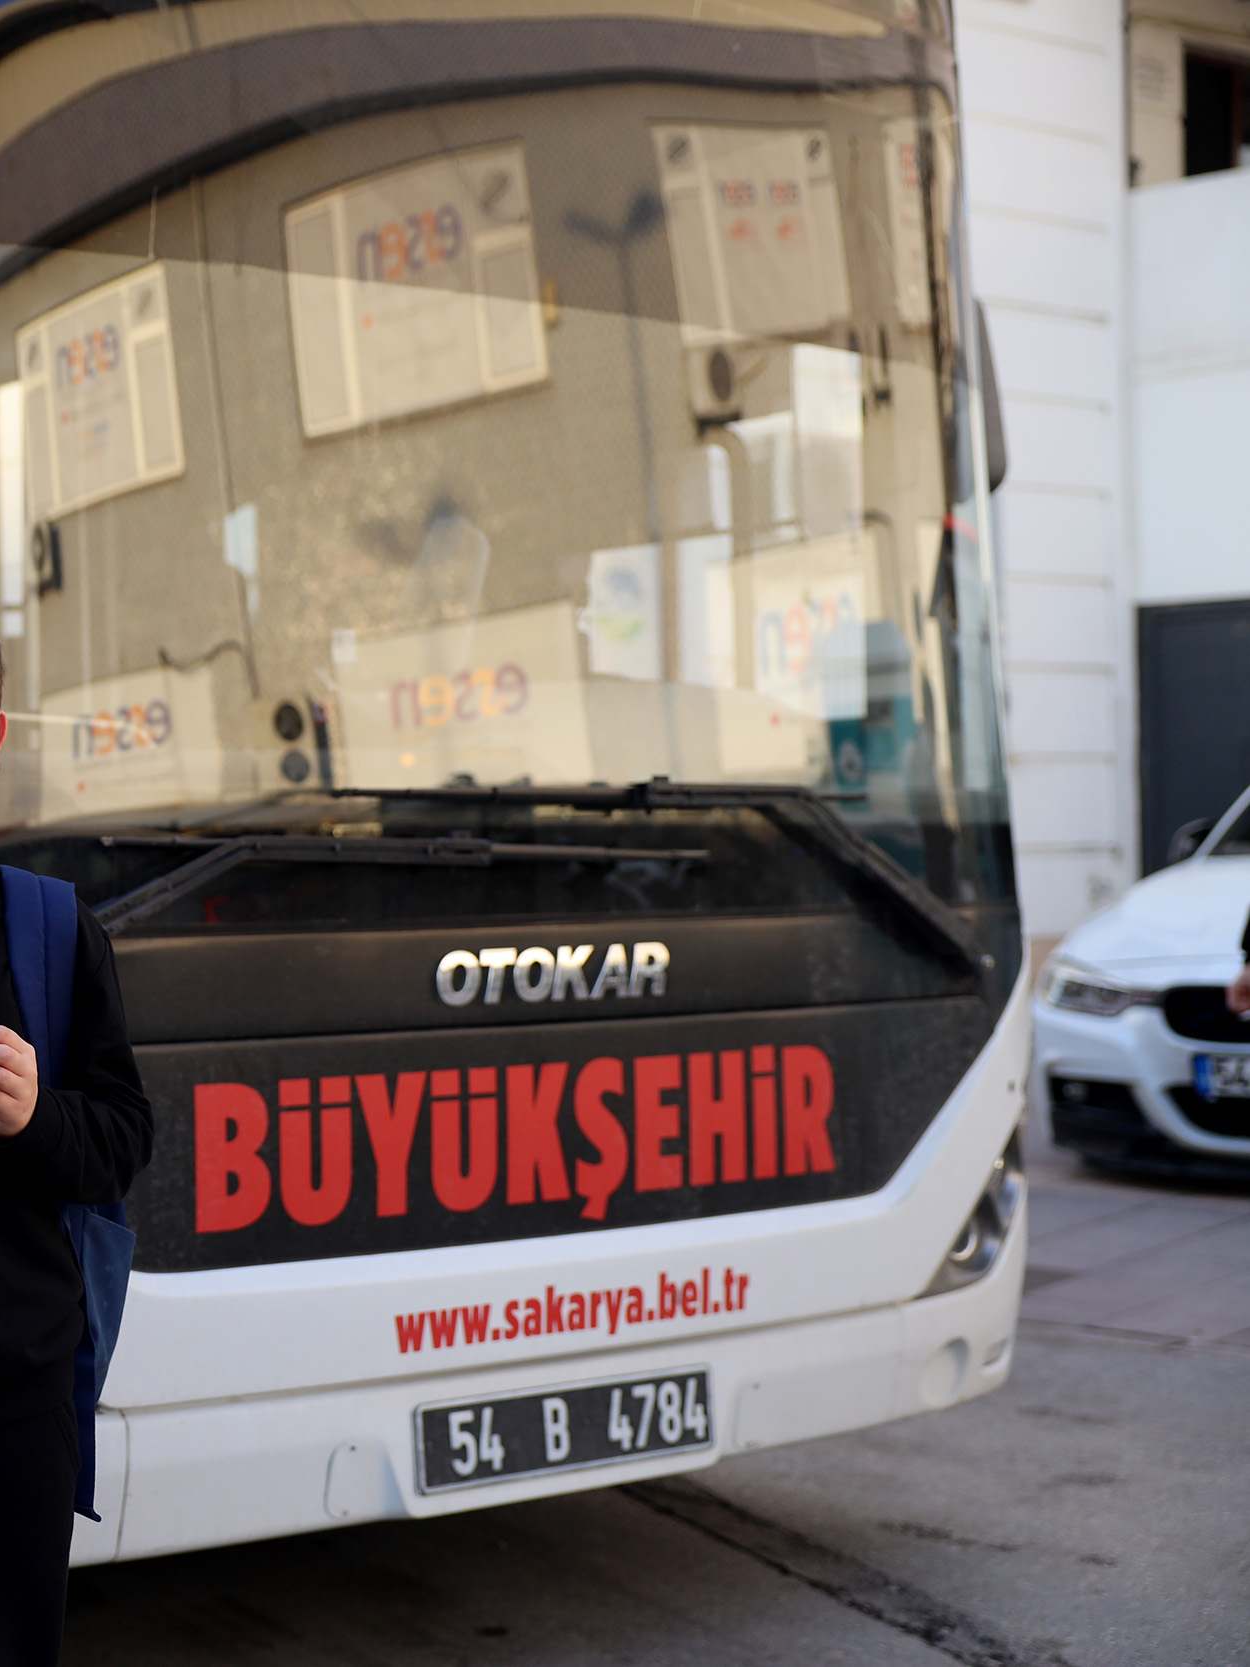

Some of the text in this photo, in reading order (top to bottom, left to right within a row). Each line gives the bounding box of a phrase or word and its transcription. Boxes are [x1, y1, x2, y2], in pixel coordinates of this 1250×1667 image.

[435, 941, 671, 1007] OTOKAR
[193, 1044, 838, 1234] BÜYÜKŞEHİR
[395, 1267, 749, 1354] www.sakarya.bel.tr
[448, 1378, 707, 1478] 54 B 4784
